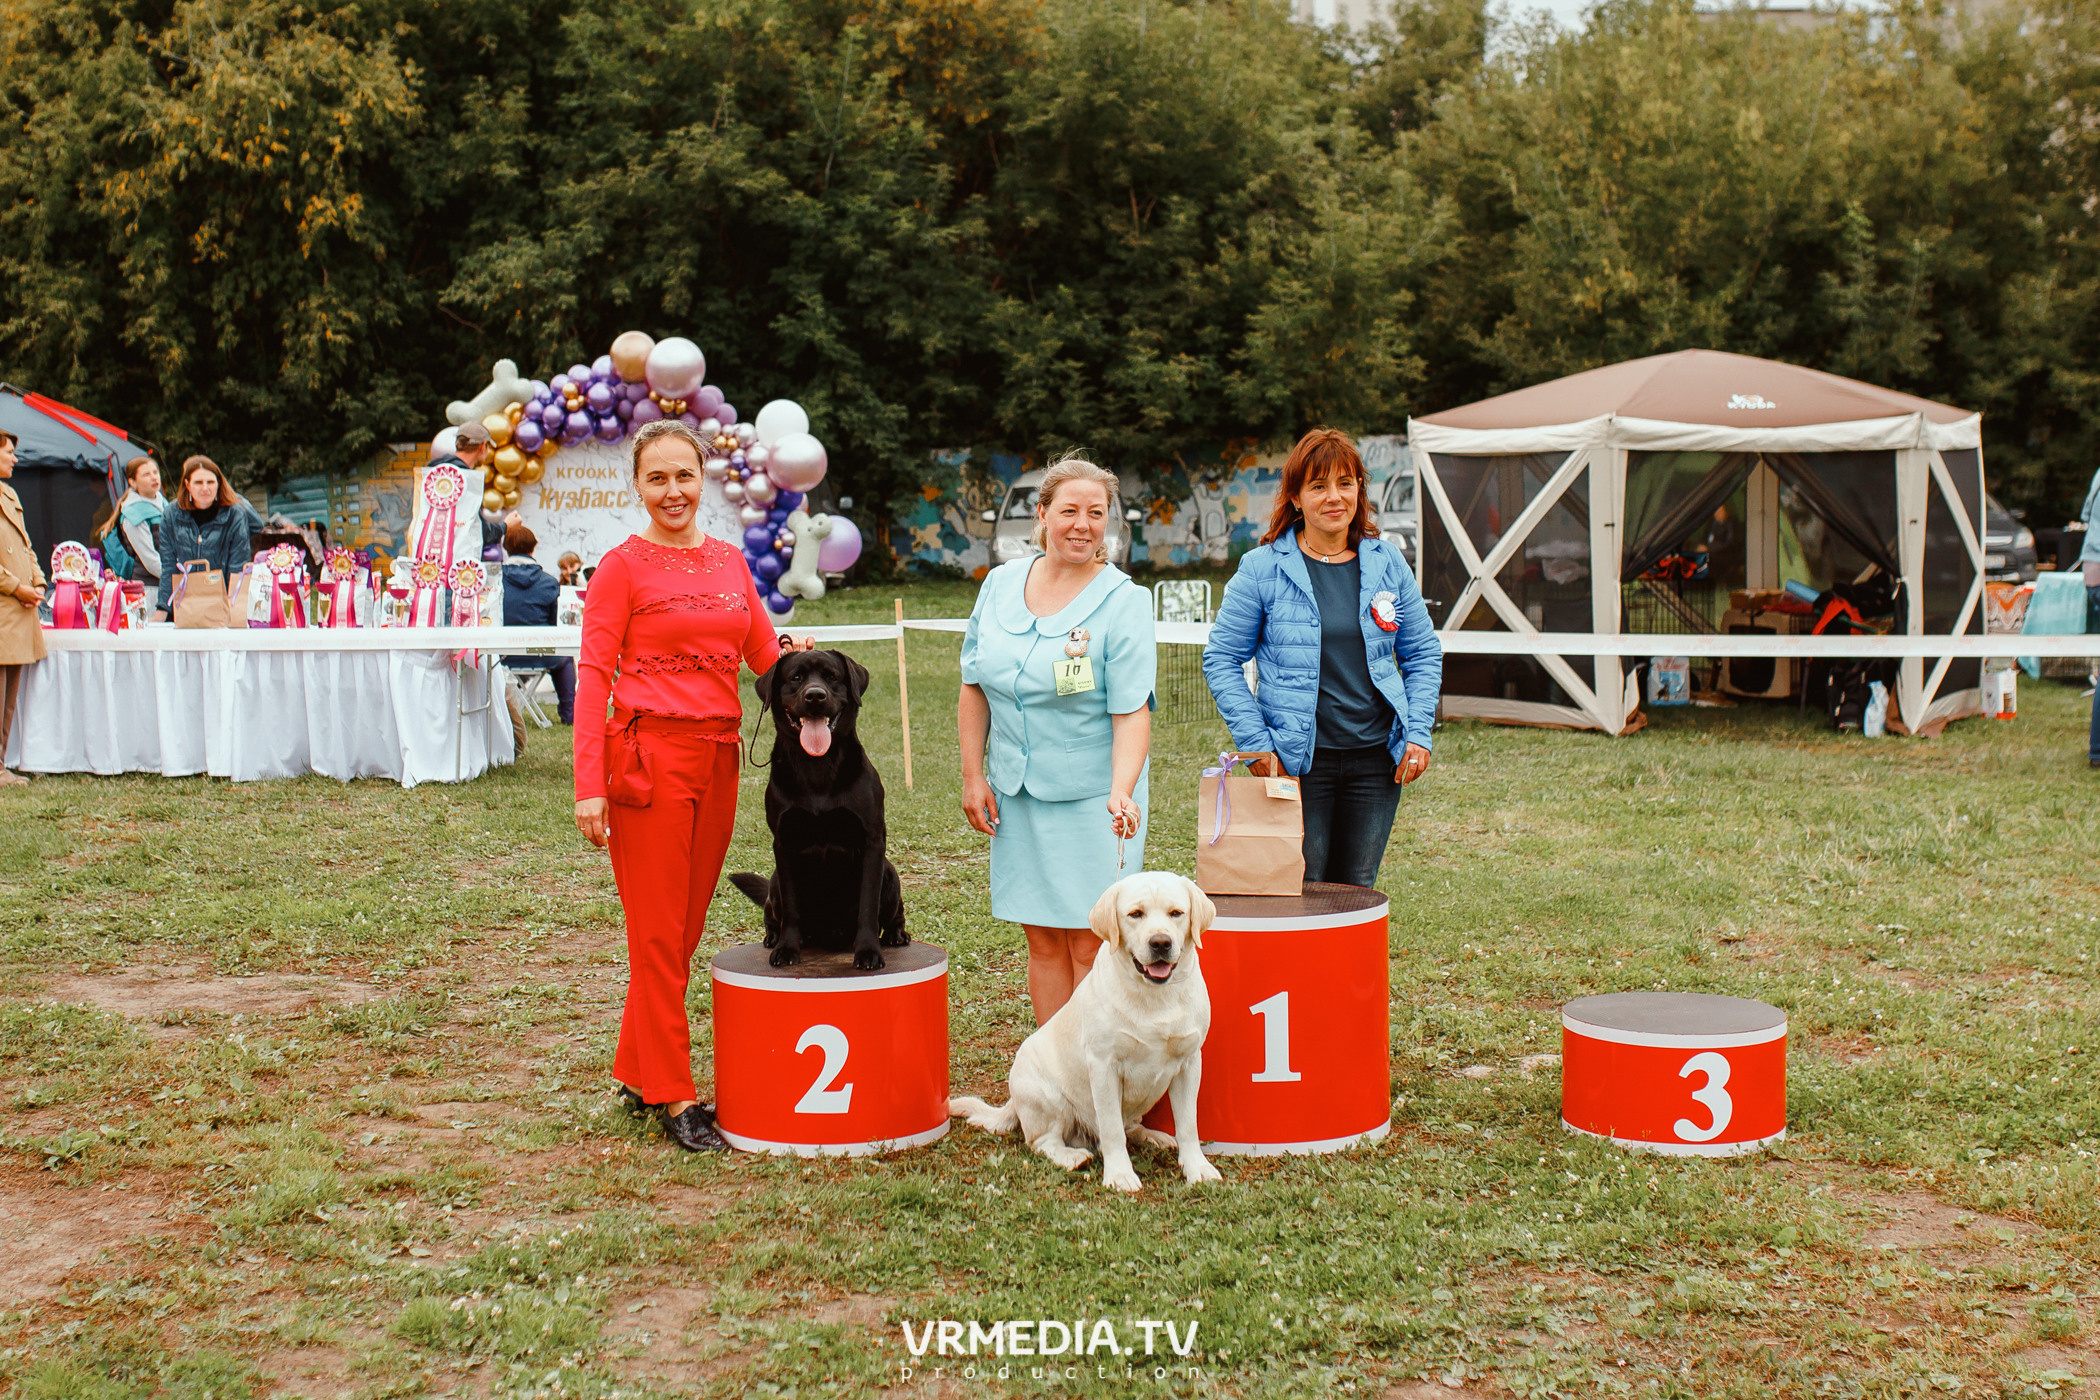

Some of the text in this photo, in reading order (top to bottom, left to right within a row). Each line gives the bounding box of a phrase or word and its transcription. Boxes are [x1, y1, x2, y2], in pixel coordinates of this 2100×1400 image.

[539, 486, 629, 512] Кузбасс
[556, 467, 618, 479] КГООКК
[794, 1024, 854, 1114] 2
[1249, 991, 1301, 1082] 1
[1673, 1051, 1733, 1142] 3
